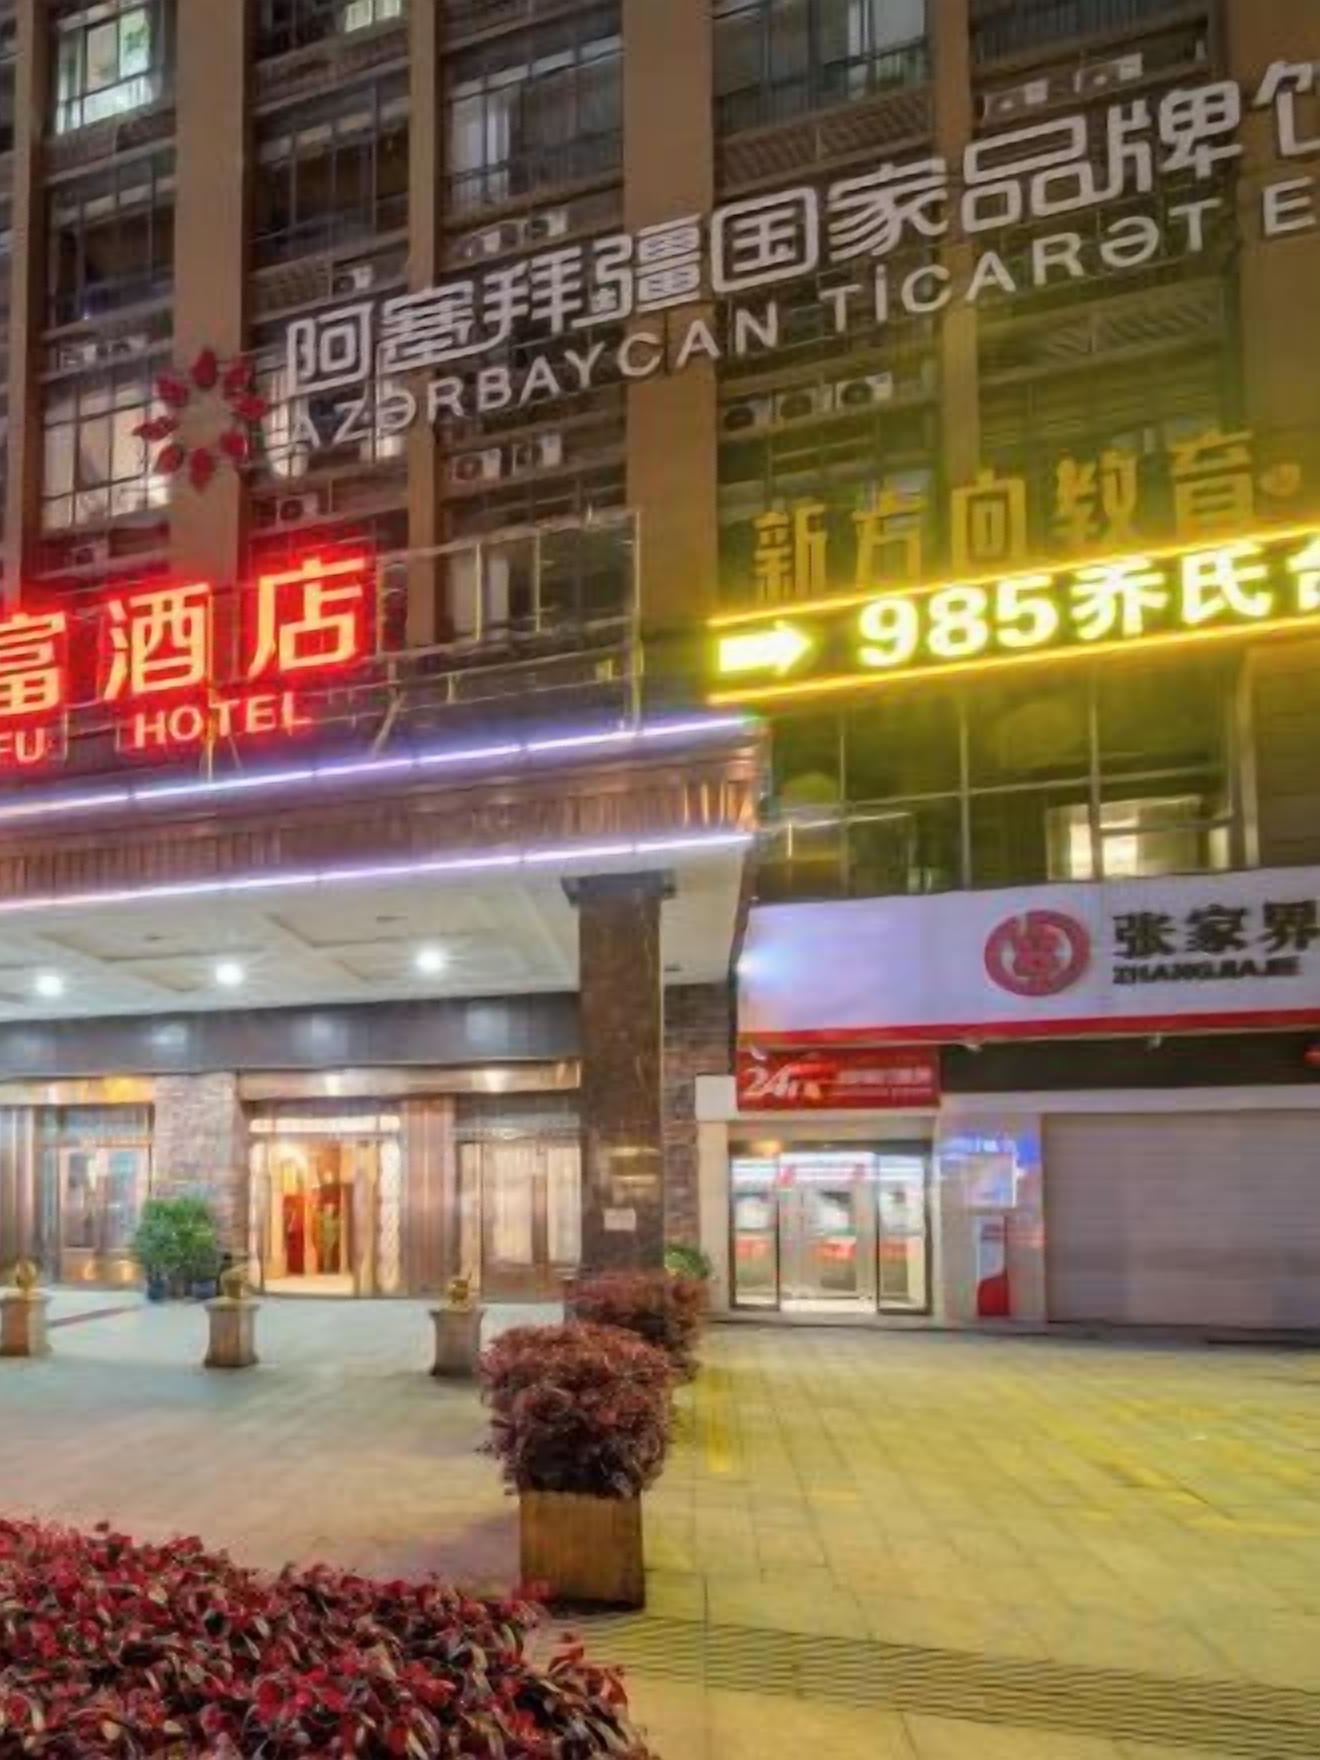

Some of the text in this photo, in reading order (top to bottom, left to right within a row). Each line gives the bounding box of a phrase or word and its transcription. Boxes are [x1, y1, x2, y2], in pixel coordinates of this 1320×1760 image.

[832, 197, 1223, 333] TİCARƏT
[752, 431, 1256, 602] 新方向教育
[133, 690, 313, 749] HOTEL
[1112, 899, 1320, 958] 张家界
